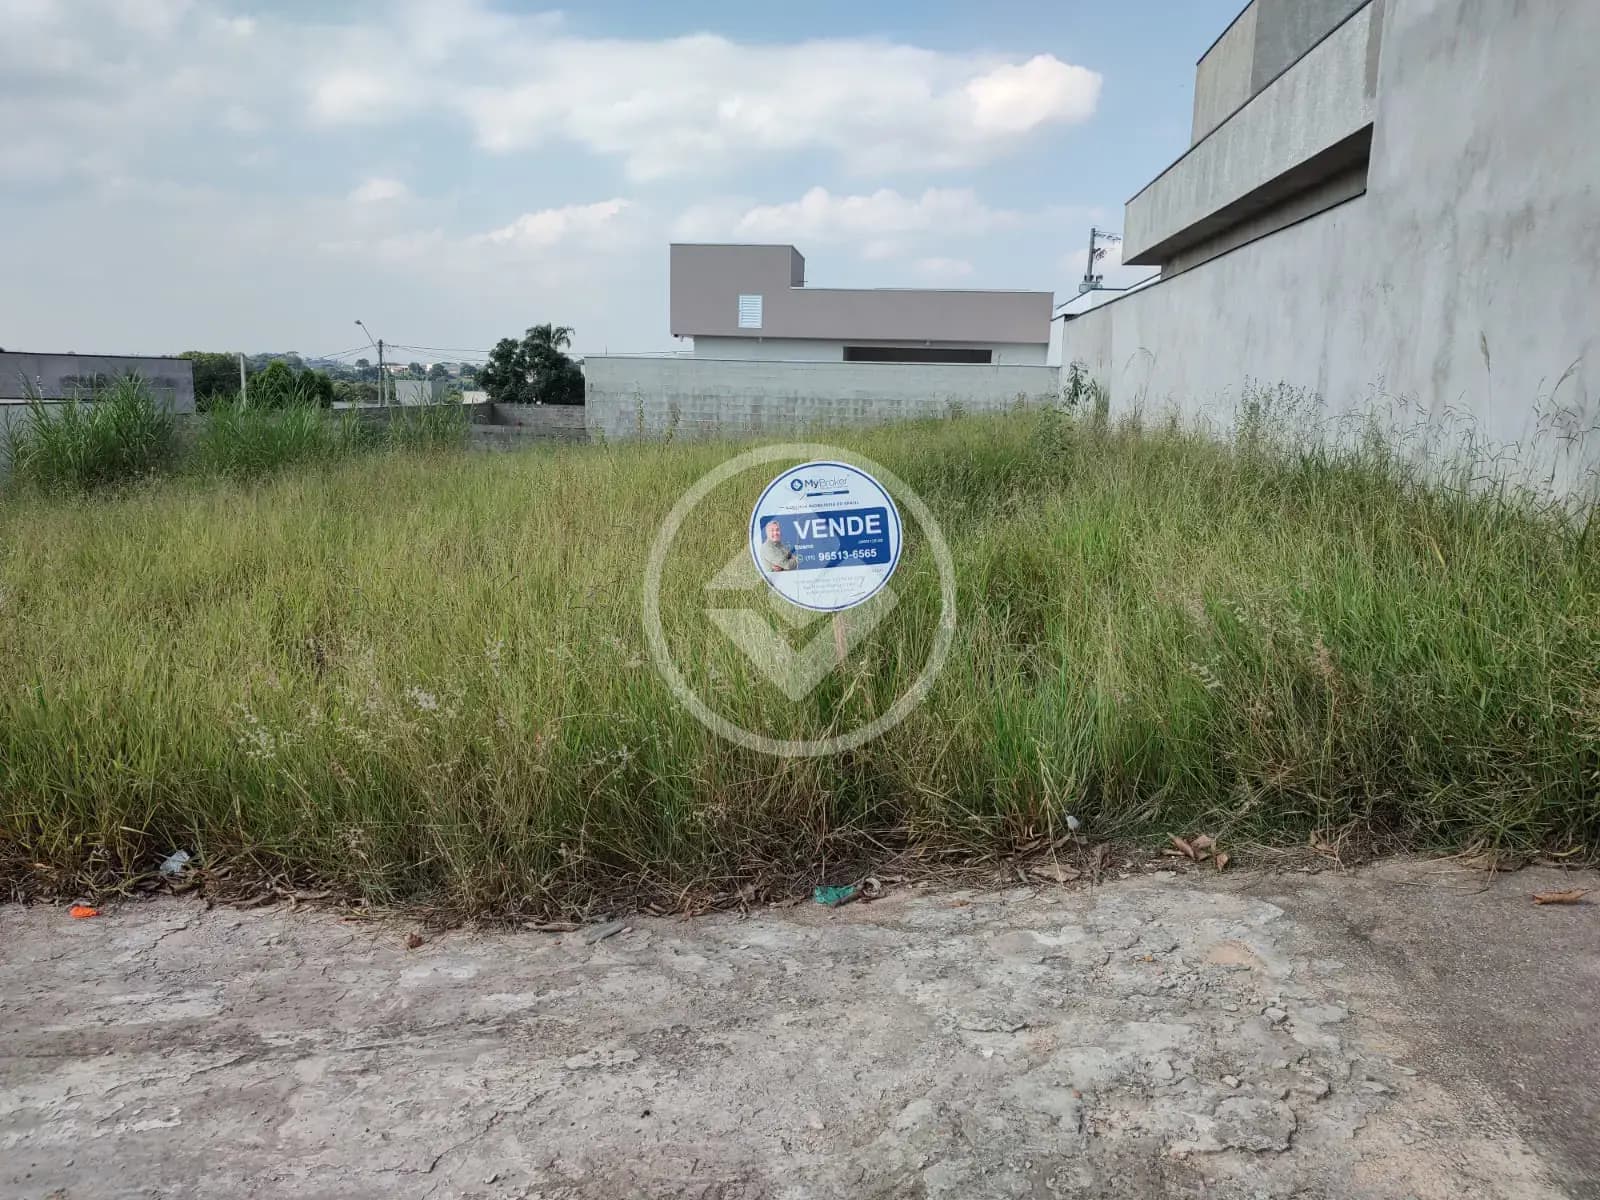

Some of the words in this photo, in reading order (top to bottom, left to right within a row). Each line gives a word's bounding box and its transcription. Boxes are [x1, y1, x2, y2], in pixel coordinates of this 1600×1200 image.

[804, 475, 849, 489] MyBroker
[793, 514, 882, 540] VENDE
[818, 548, 877, 562] 96513-6565
